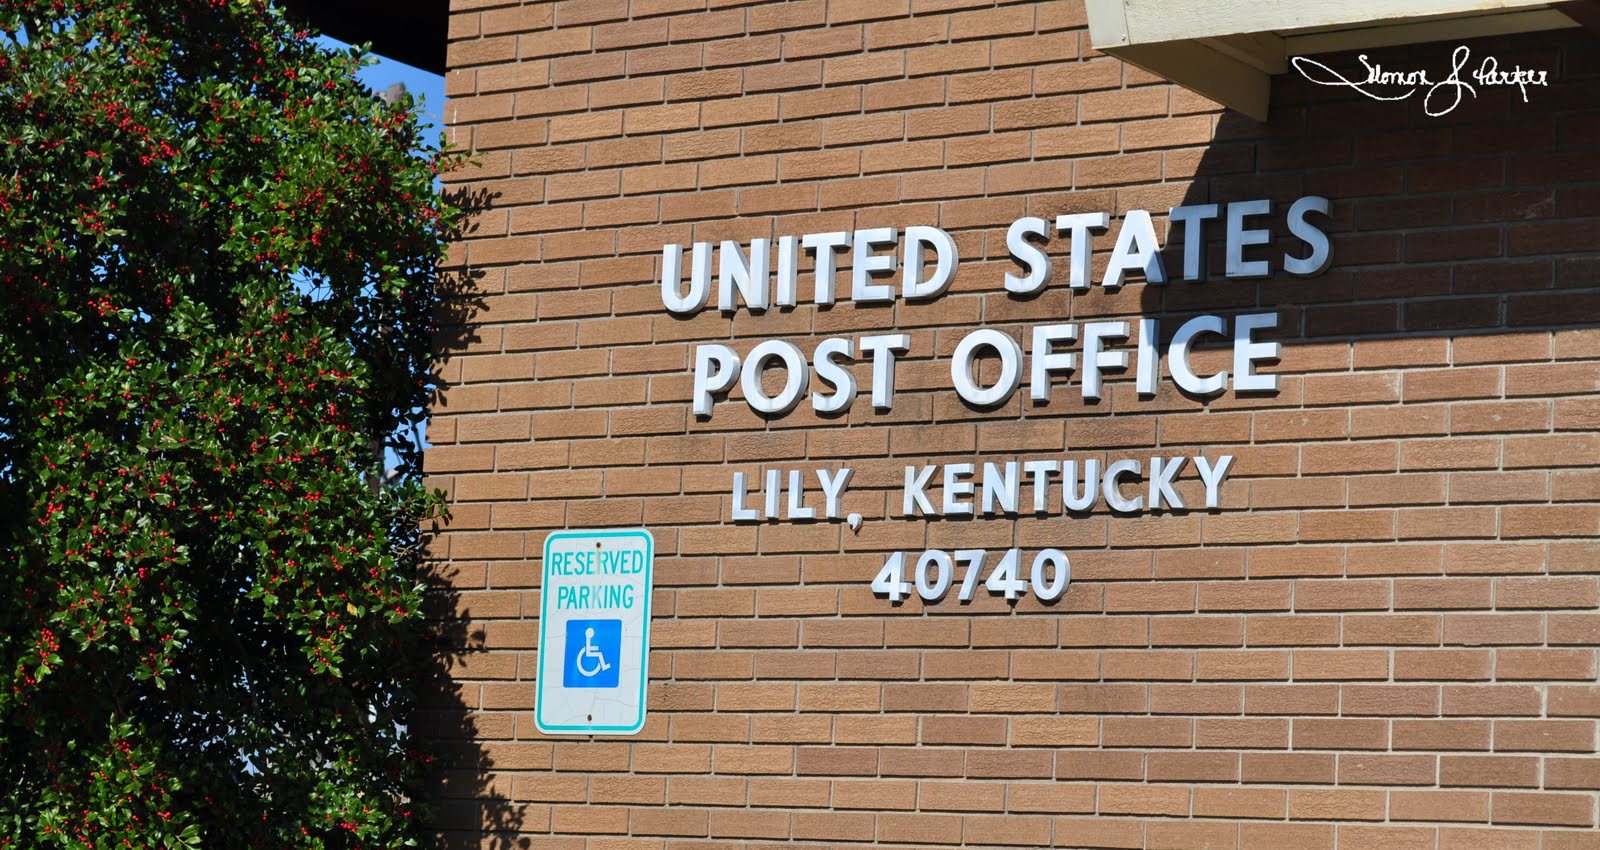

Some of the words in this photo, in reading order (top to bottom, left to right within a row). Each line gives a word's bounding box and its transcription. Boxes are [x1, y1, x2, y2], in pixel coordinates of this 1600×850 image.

[661, 225, 959, 313] UNITED
[1004, 196, 1333, 295] STATES
[693, 333, 911, 417] POST
[950, 312, 1282, 406] OFFICE
[732, 468, 863, 531] LILY,
[903, 455, 1236, 516] KENTUCKY
[551, 550, 644, 576] RESERVED
[870, 548, 1070, 601] 40740
[557, 584, 634, 609] PARKING
